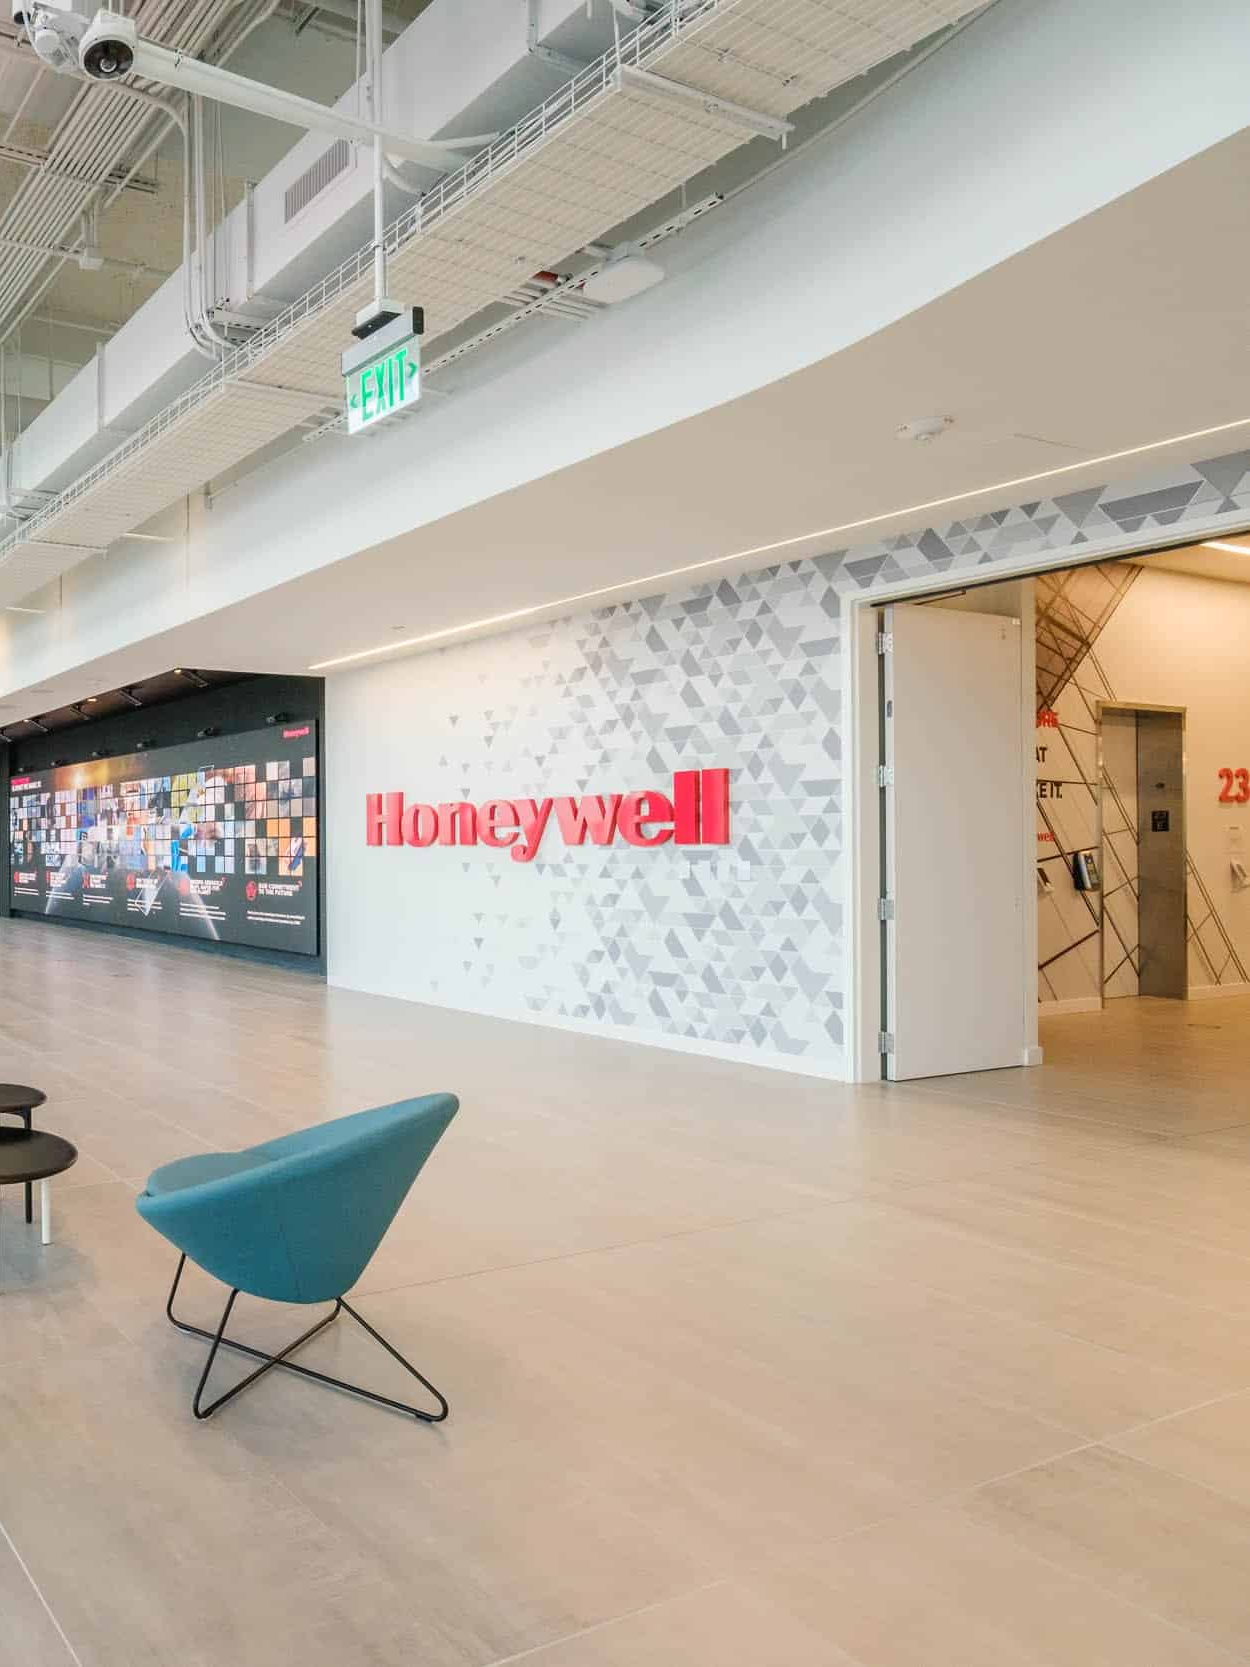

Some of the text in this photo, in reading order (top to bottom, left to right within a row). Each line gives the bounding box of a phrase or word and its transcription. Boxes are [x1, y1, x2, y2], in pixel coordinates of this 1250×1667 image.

[361, 349, 407, 421] EXIT
[366, 768, 730, 863] Honeywell
[1218, 767, 1250, 803] 23
